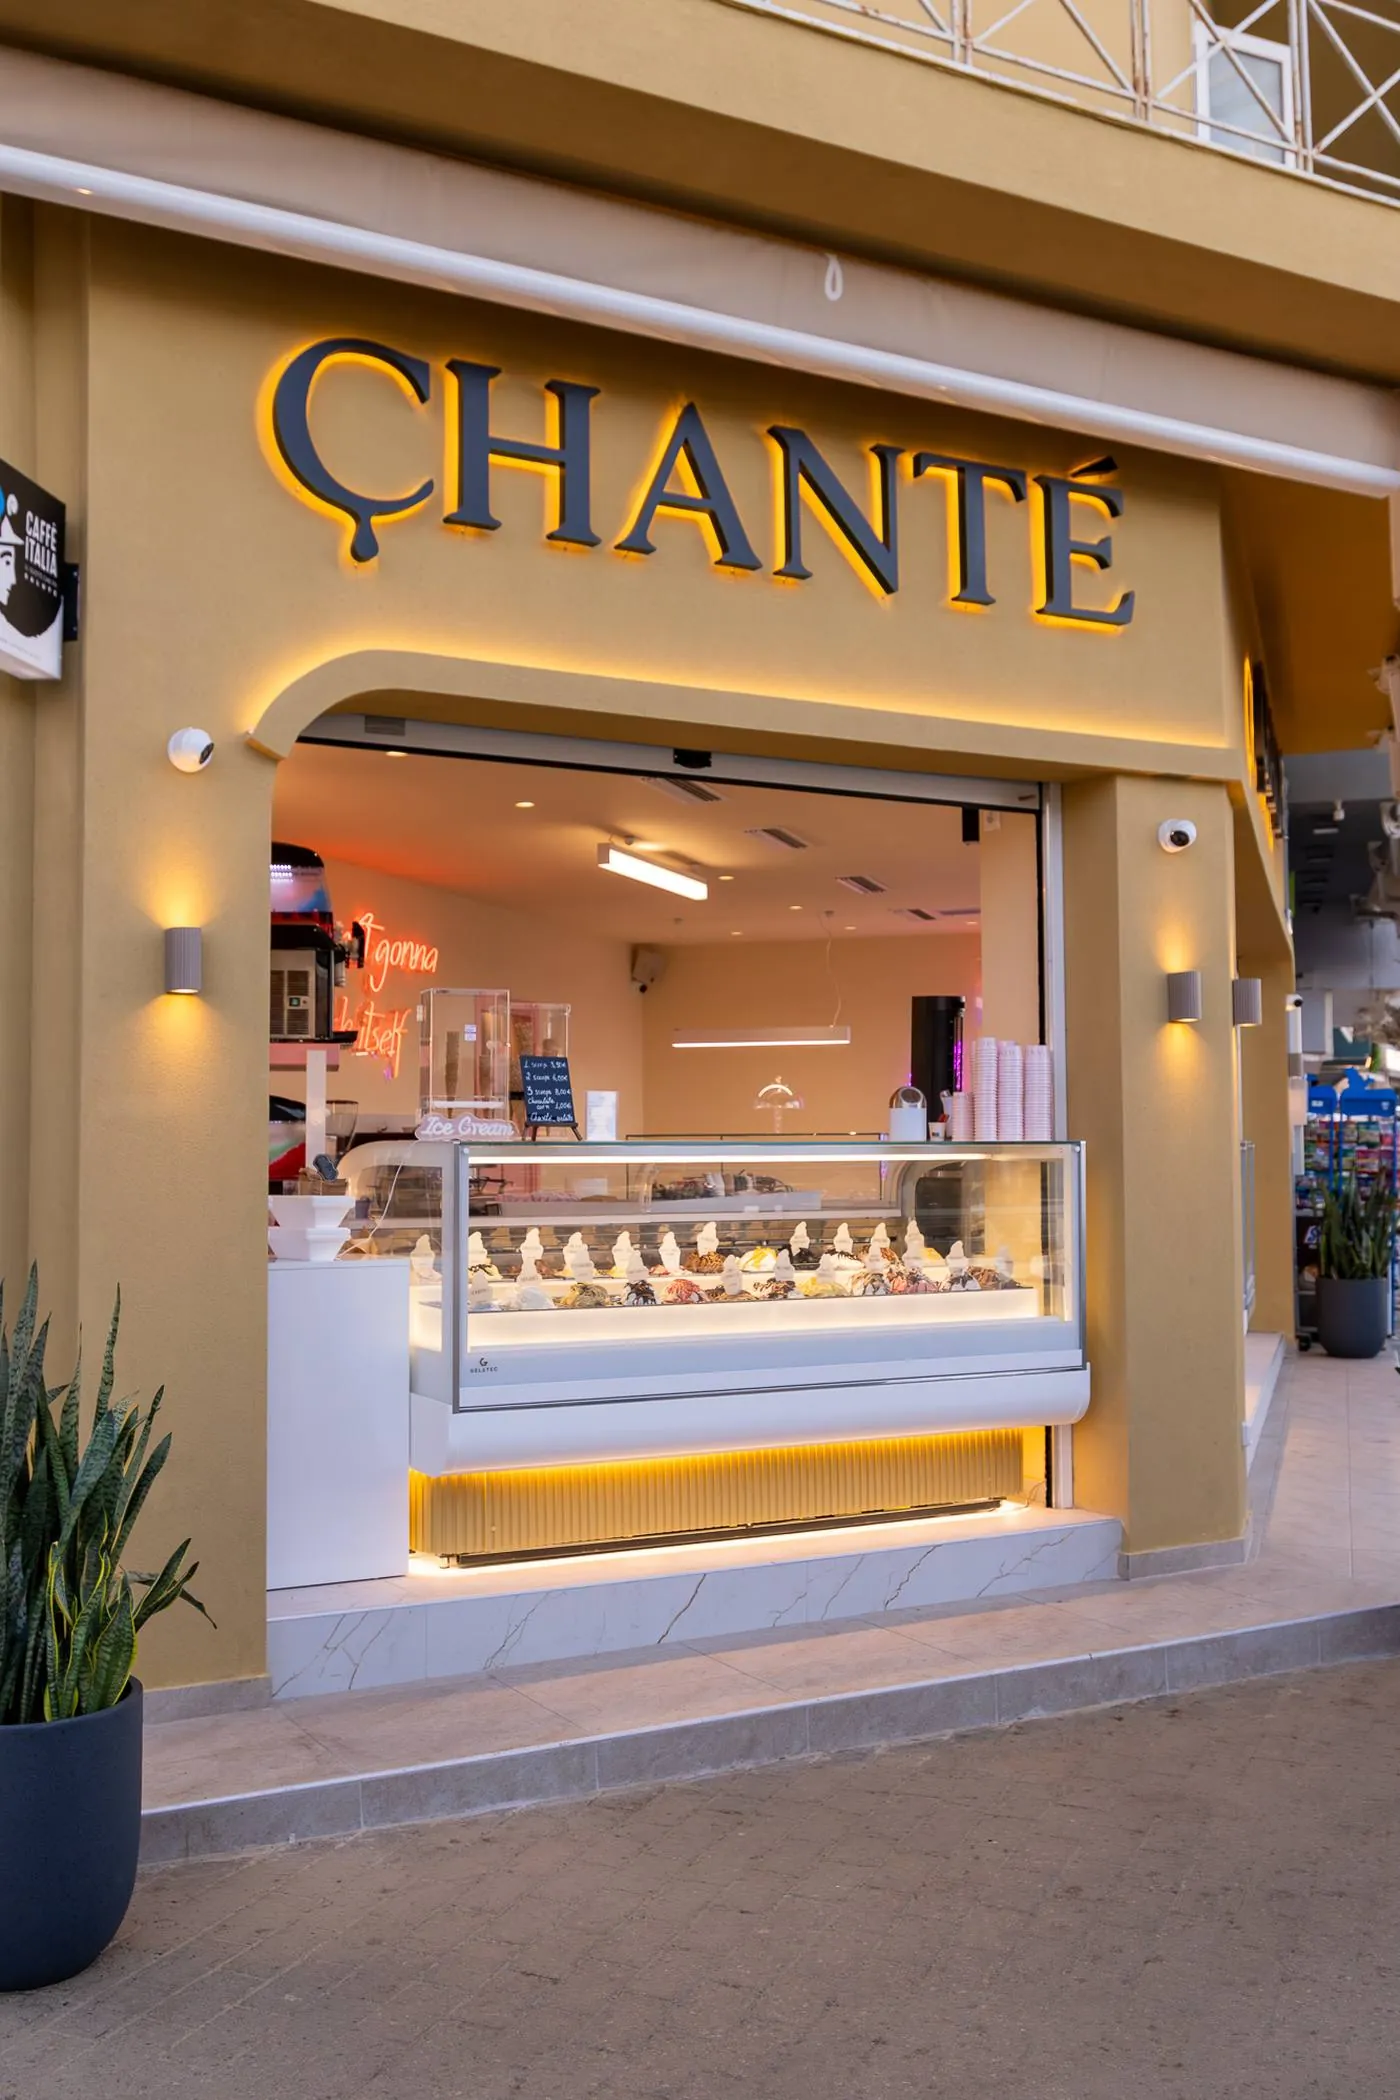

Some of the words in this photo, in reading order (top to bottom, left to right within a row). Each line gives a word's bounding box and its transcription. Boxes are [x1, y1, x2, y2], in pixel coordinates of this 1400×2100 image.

[269, 337, 1136, 628] ÇHANTÉ
[24, 535, 58, 578] ITALIA
[369, 938, 439, 993] gonna
[357, 1001, 412, 1079] itself
[525, 1071, 531, 1081] 2
[526, 1086, 533, 1096] 3
[421, 1116, 455, 1135] Ice
[458, 1115, 514, 1136] Cream
